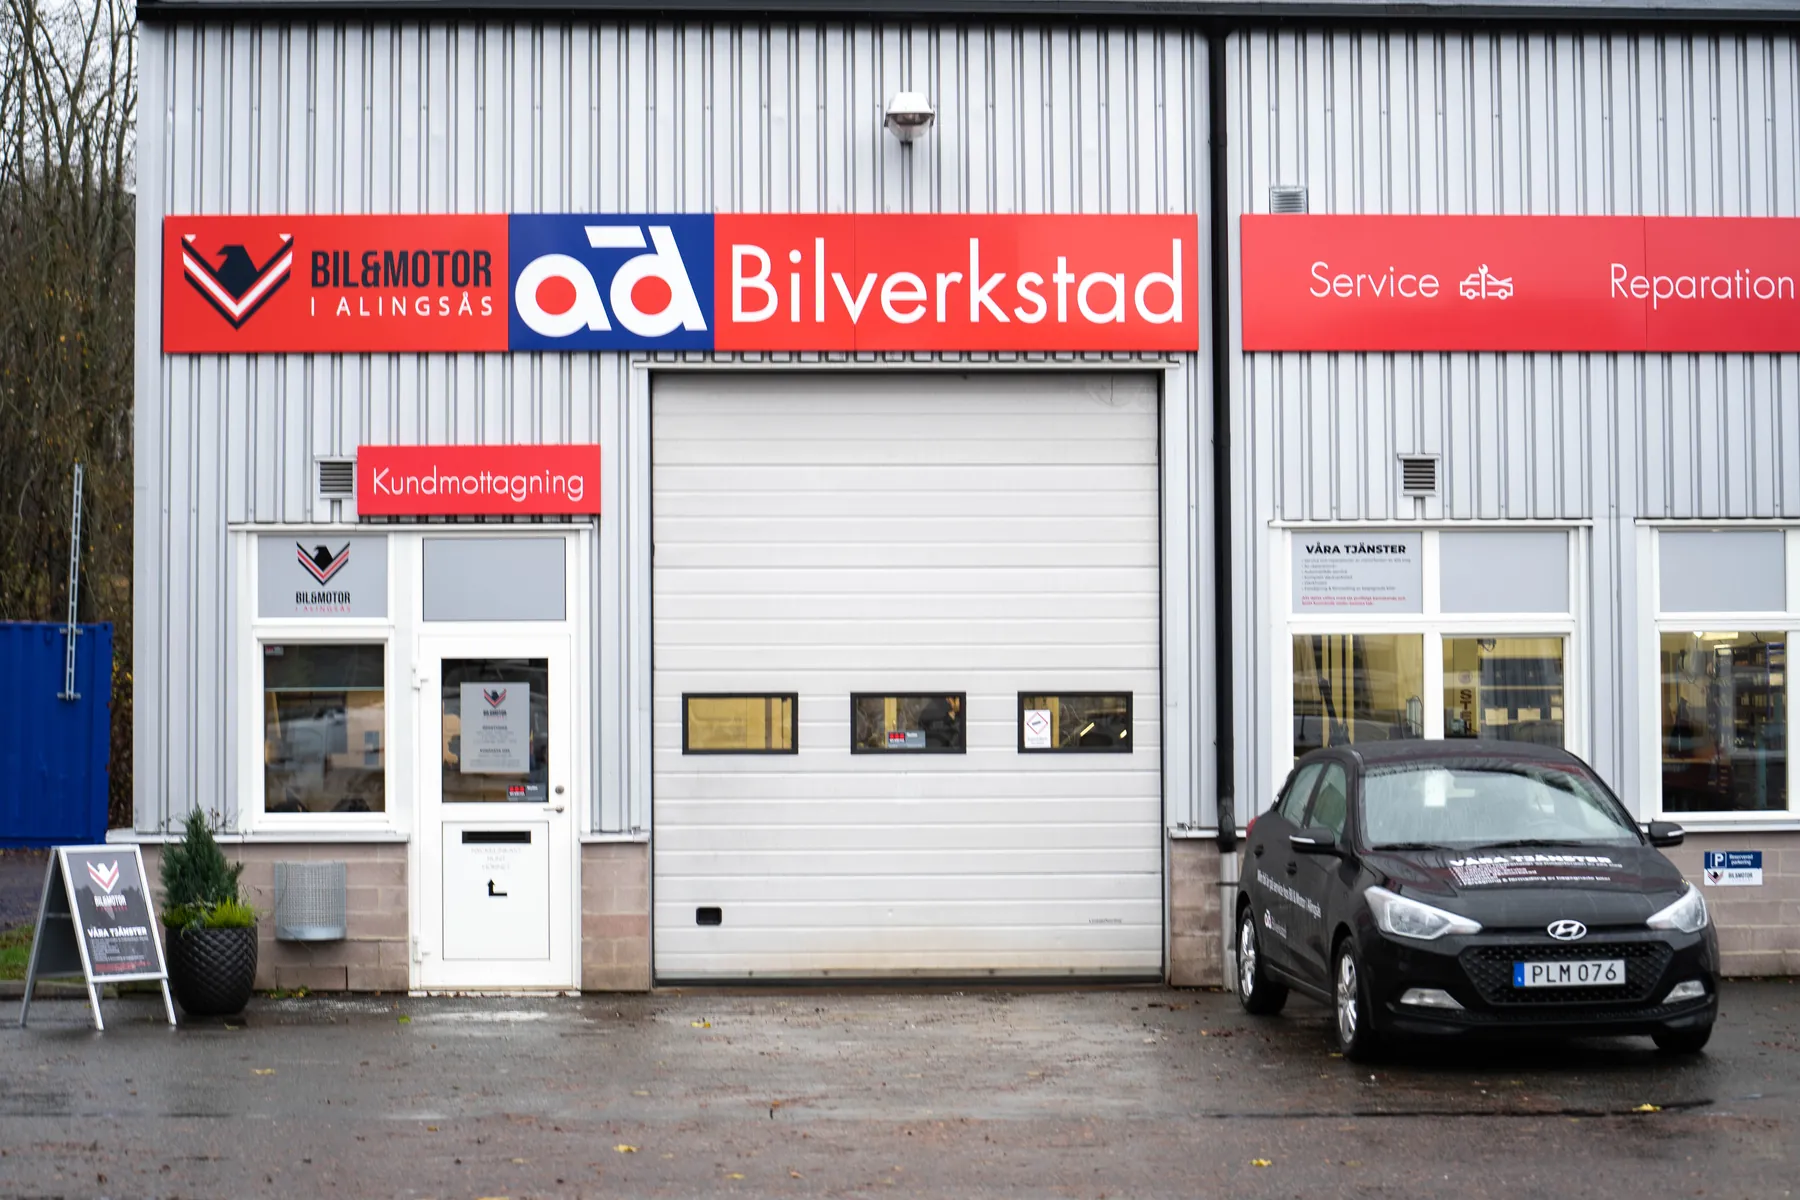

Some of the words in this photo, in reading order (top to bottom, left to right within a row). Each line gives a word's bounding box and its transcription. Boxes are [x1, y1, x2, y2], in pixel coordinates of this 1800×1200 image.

[311, 249, 492, 289] BIL&MOTOR
[731, 237, 1183, 325] Bilverkstad
[1310, 261, 1440, 299] Service
[1610, 262, 1796, 310] Reparation
[311, 296, 315, 317] I
[336, 291, 493, 317] ALINGSÅS
[373, 465, 584, 503] Kundmottagning
[1306, 541, 1341, 554] VÅRA
[1344, 541, 1406, 554] TJÄNSTER
[295, 591, 351, 604] BIL&MOTOR
[1532, 964, 1571, 984] PLM
[1578, 963, 1617, 982] 076
